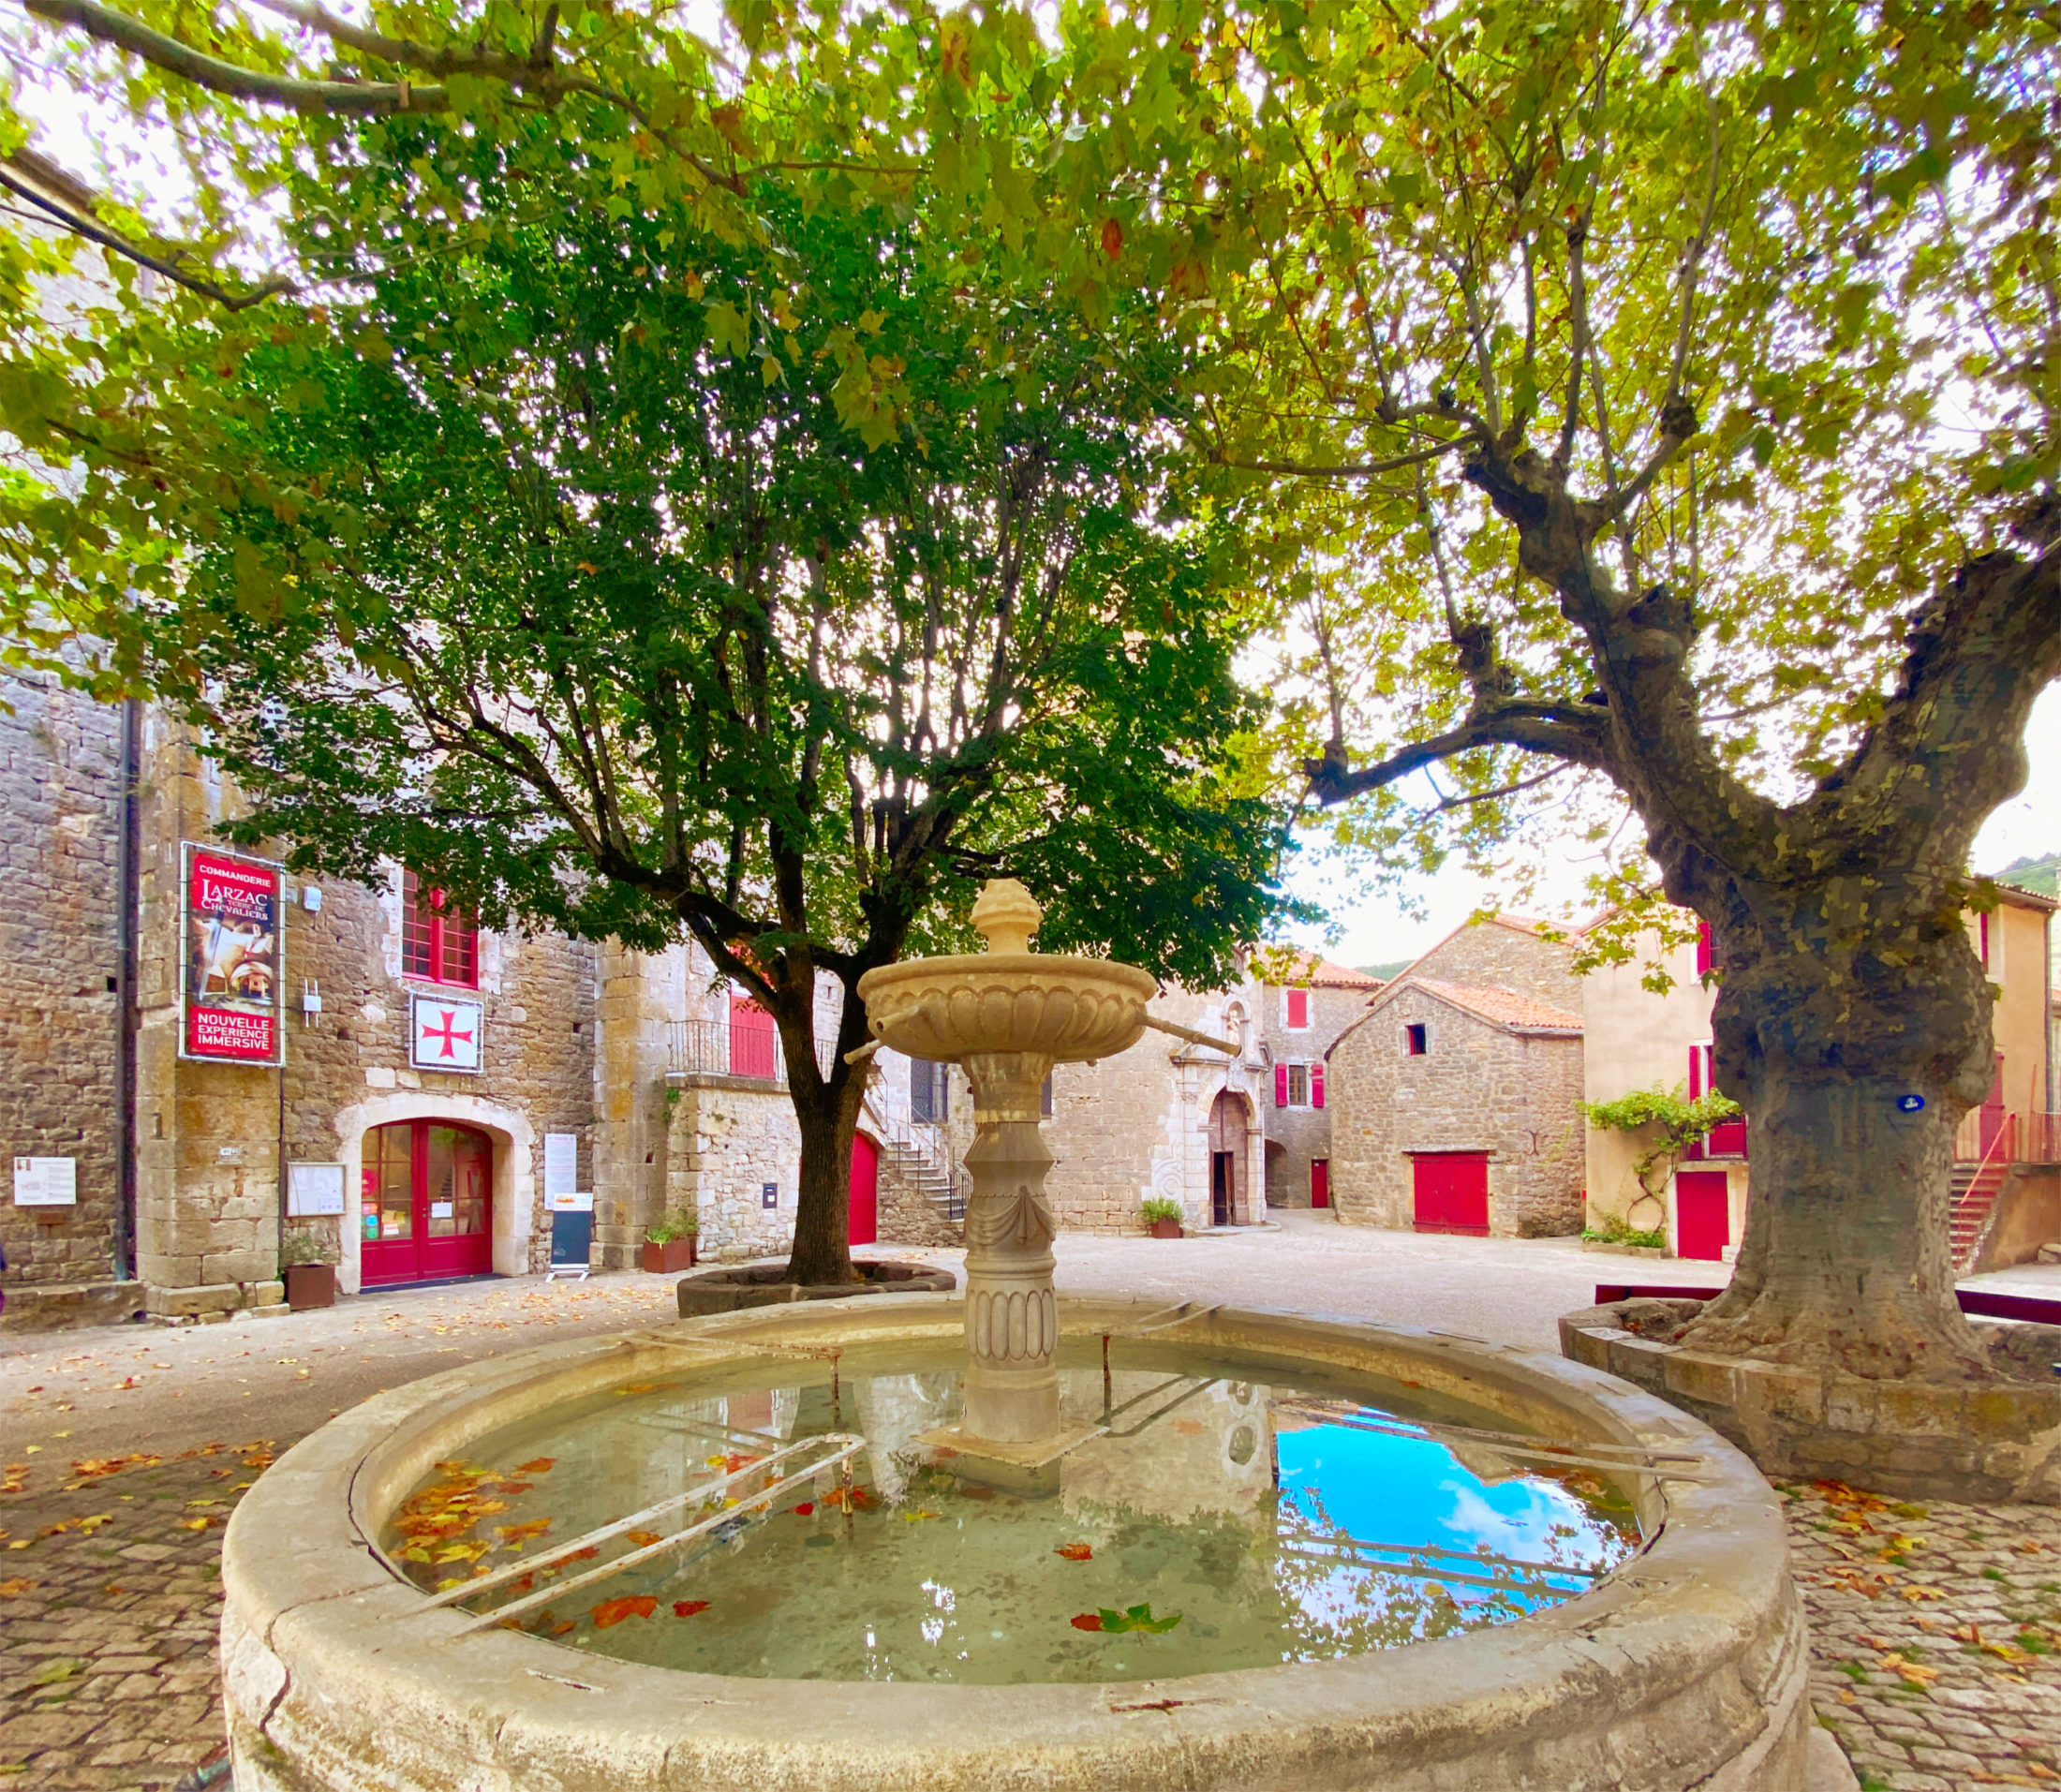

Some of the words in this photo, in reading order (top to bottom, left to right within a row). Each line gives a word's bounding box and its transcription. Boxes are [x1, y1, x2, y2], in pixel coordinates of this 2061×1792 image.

[200, 865, 271, 887] COMMANDERIE
[201, 879, 268, 907] LARZAC
[200, 899, 269, 921] CHEVALIERS
[198, 1013, 270, 1030] NOUVELLE
[198, 1024, 270, 1040] EXPERIENCE
[198, 1034, 270, 1050] IMMERSIVE
